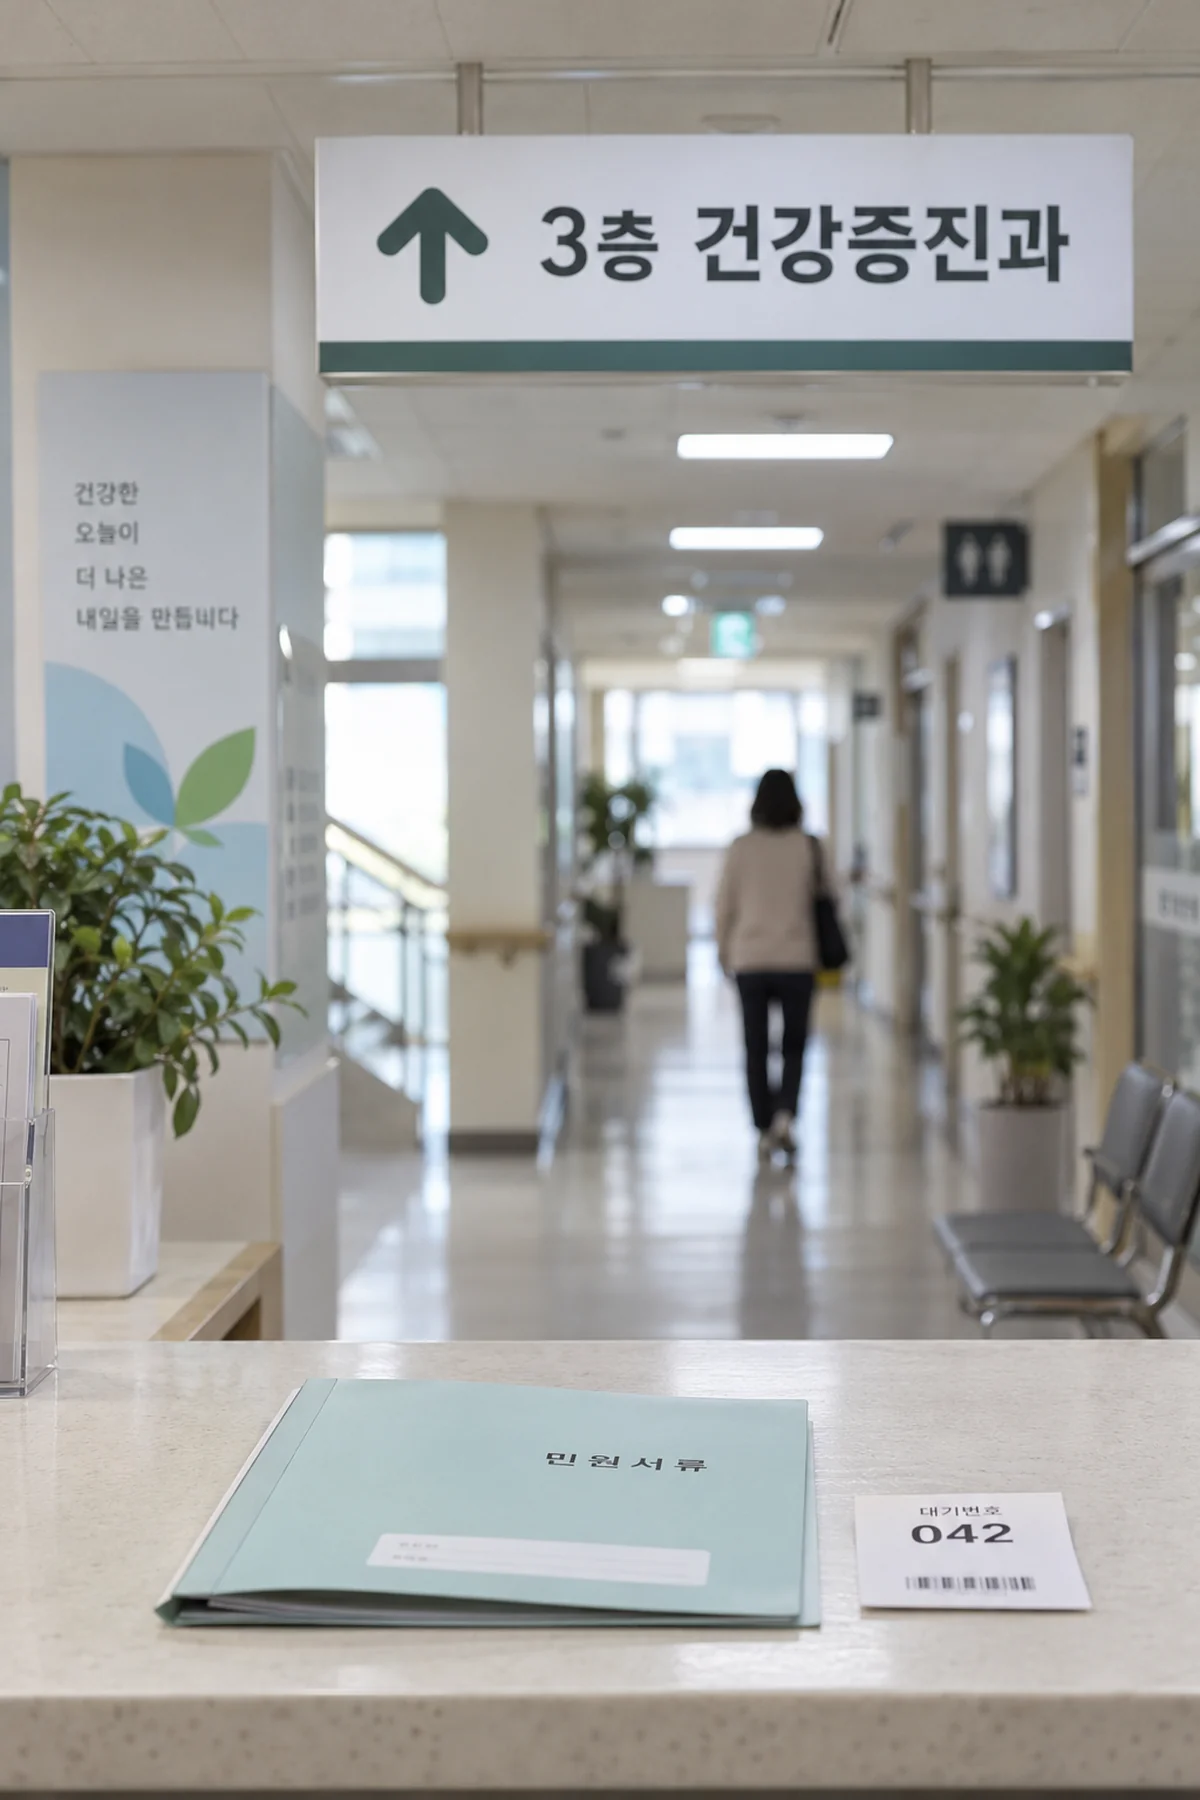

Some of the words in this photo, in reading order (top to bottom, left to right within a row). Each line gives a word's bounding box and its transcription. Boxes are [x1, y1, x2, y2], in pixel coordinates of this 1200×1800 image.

[541, 205, 659, 283] 3층
[695, 204, 1070, 284] 건강증진과
[75, 481, 138, 506] 건강한
[75, 520, 139, 546] 오늘이
[76, 565, 95, 590] 더
[104, 565, 148, 590] 나은
[76, 606, 141, 631] 내일을
[919, 1505, 1002, 1517] 대기번호
[911, 1523, 1014, 1544] 042
